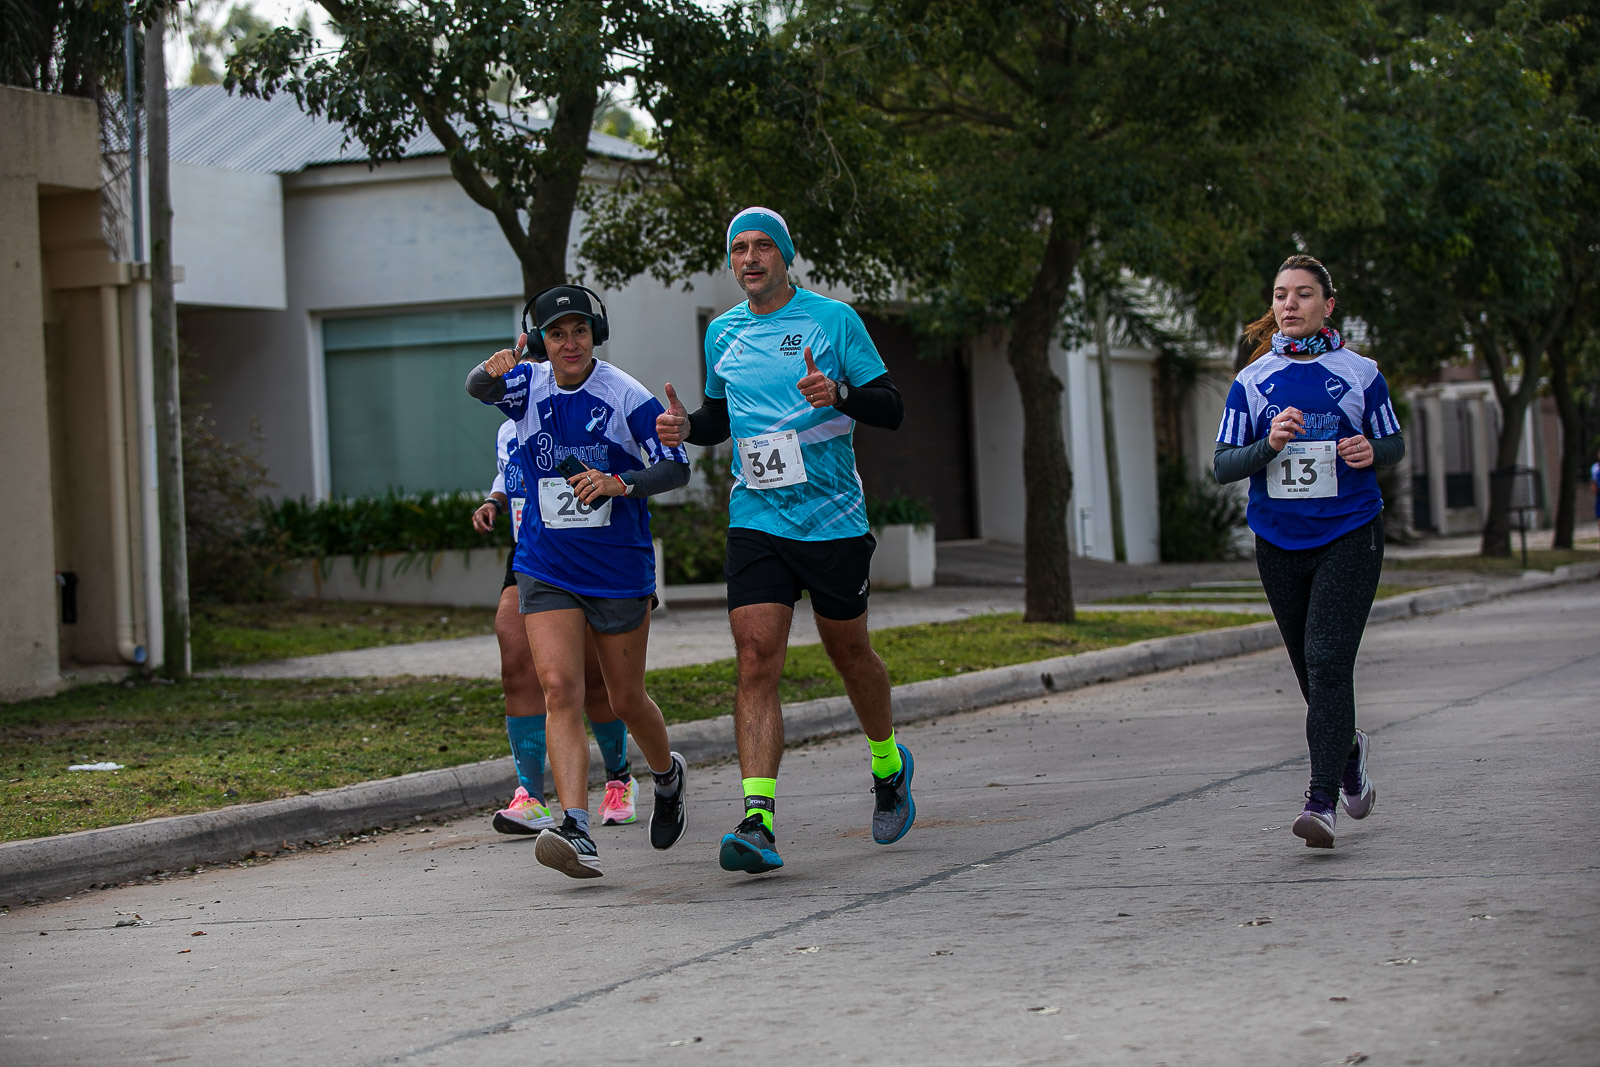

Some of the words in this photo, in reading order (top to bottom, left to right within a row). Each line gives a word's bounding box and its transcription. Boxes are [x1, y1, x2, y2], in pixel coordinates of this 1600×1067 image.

[781, 334, 803, 346] AG
[536, 432, 553, 472] 3
[747, 448, 787, 478] 34
[1281, 459, 1317, 485] 13
